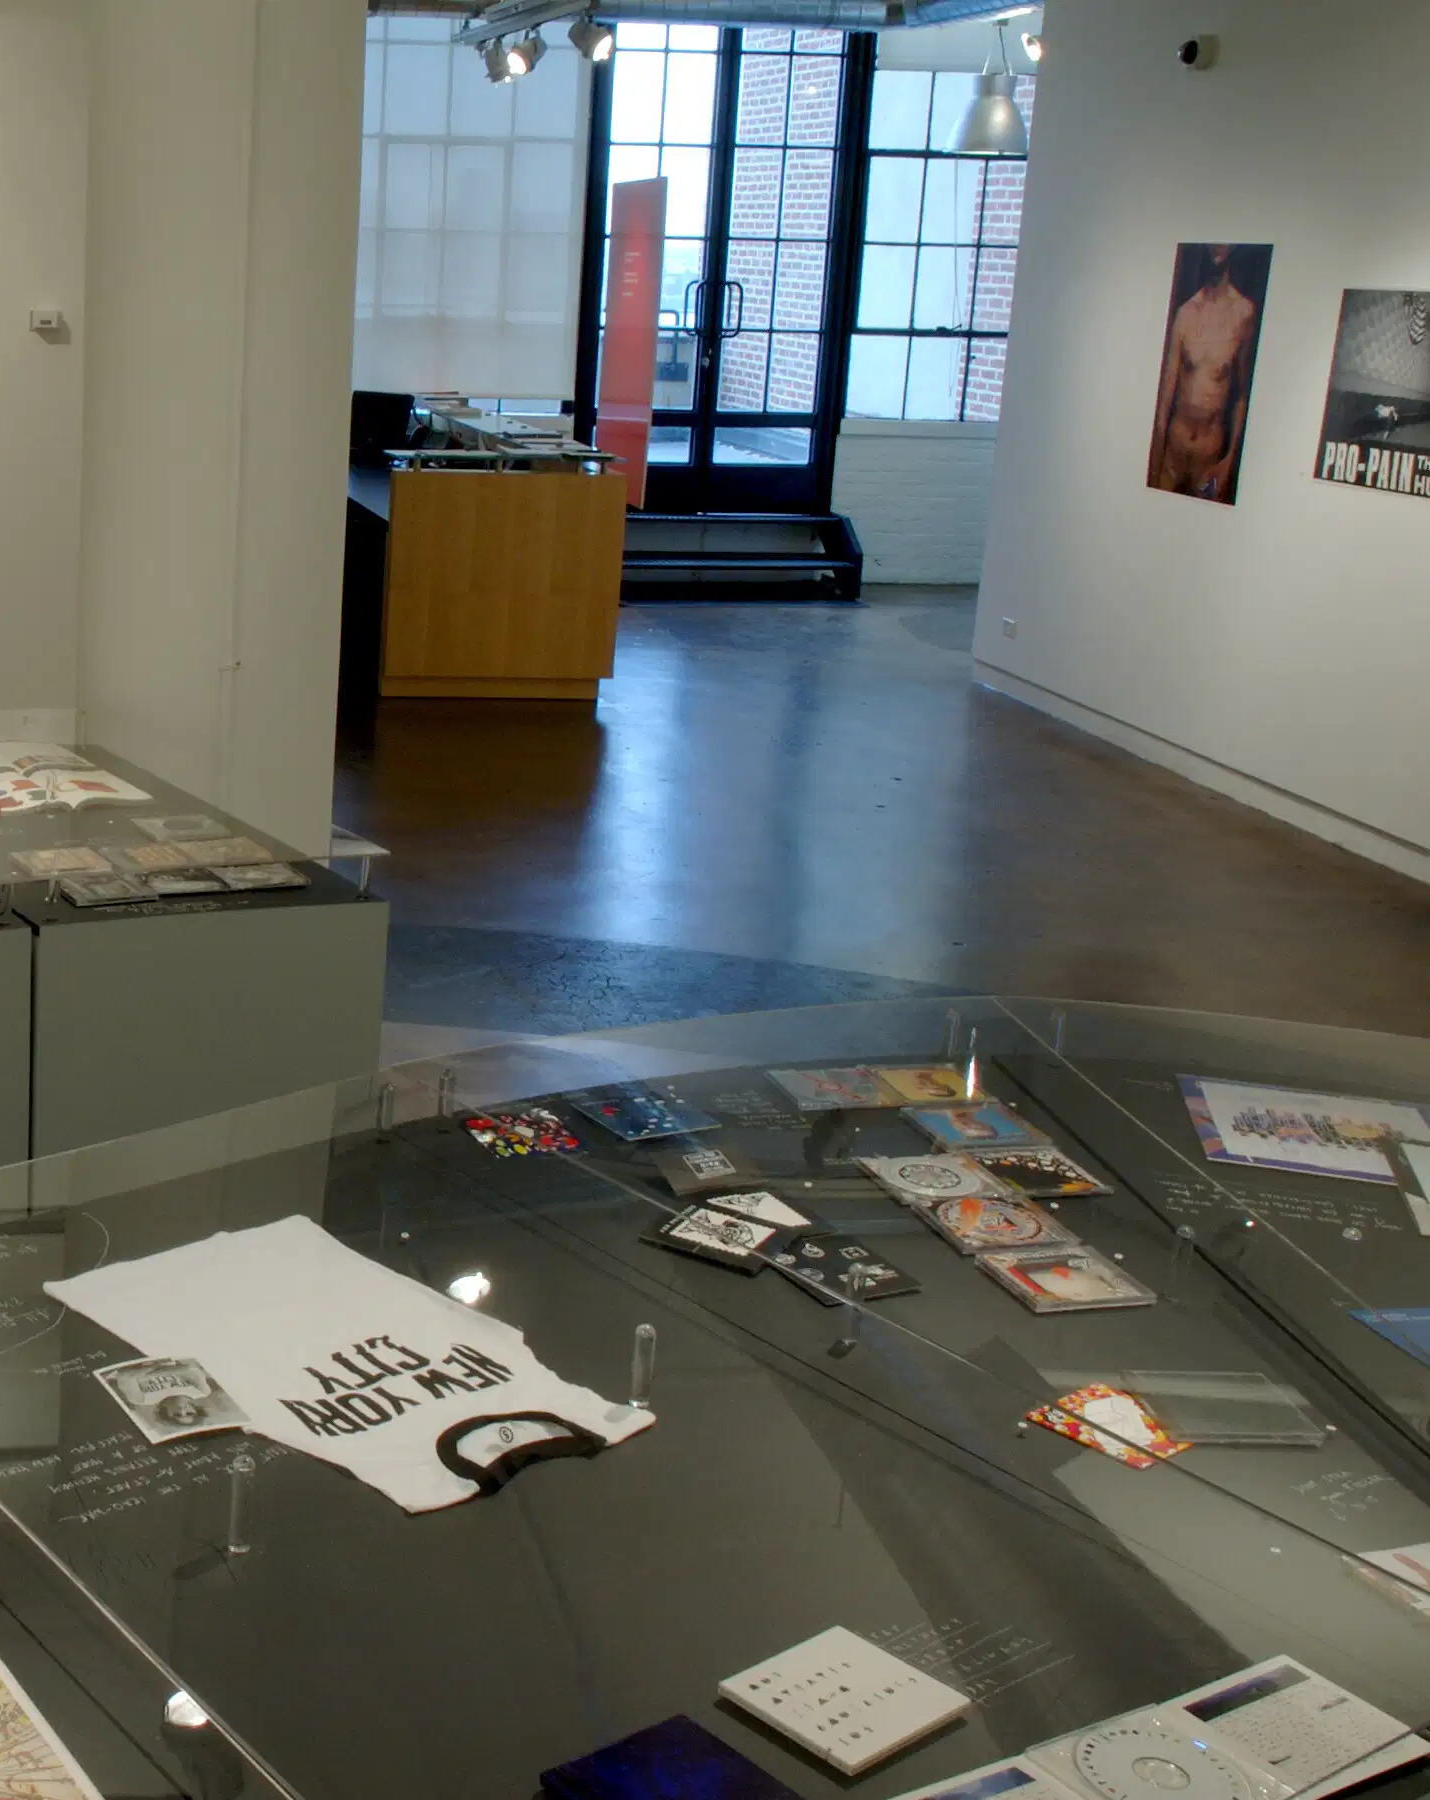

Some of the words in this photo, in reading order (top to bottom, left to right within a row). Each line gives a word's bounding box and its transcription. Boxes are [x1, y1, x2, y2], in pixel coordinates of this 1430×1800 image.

[1322, 441, 1415, 493] PRO-PAIN
[302, 1335, 431, 1394] CITY
[412, 1343, 515, 1400] NEW
[276, 1386, 422, 1437] YORK
